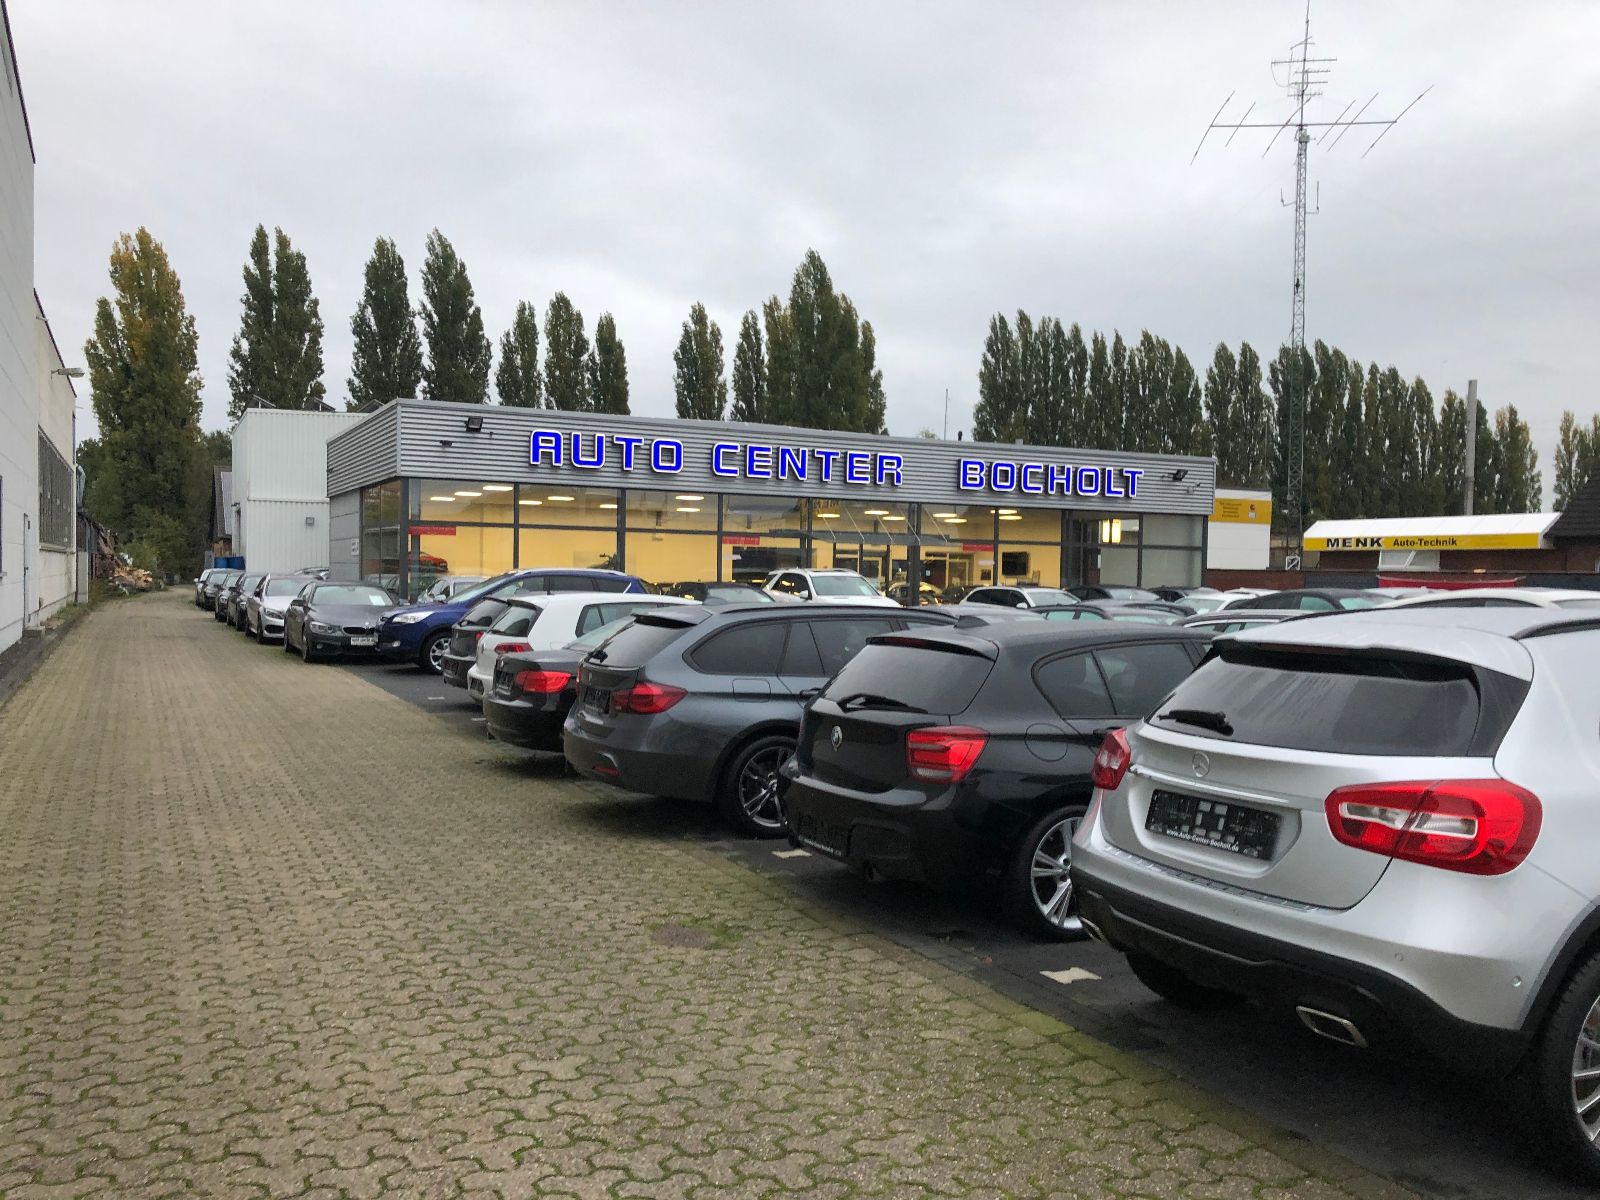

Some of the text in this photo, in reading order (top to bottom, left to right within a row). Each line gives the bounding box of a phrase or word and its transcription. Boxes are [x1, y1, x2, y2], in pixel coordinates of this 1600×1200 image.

[529, 429, 1144, 498] AUTO CENTER BOCHOLT
[1326, 537, 1457, 548] MENK Auto-Technik
